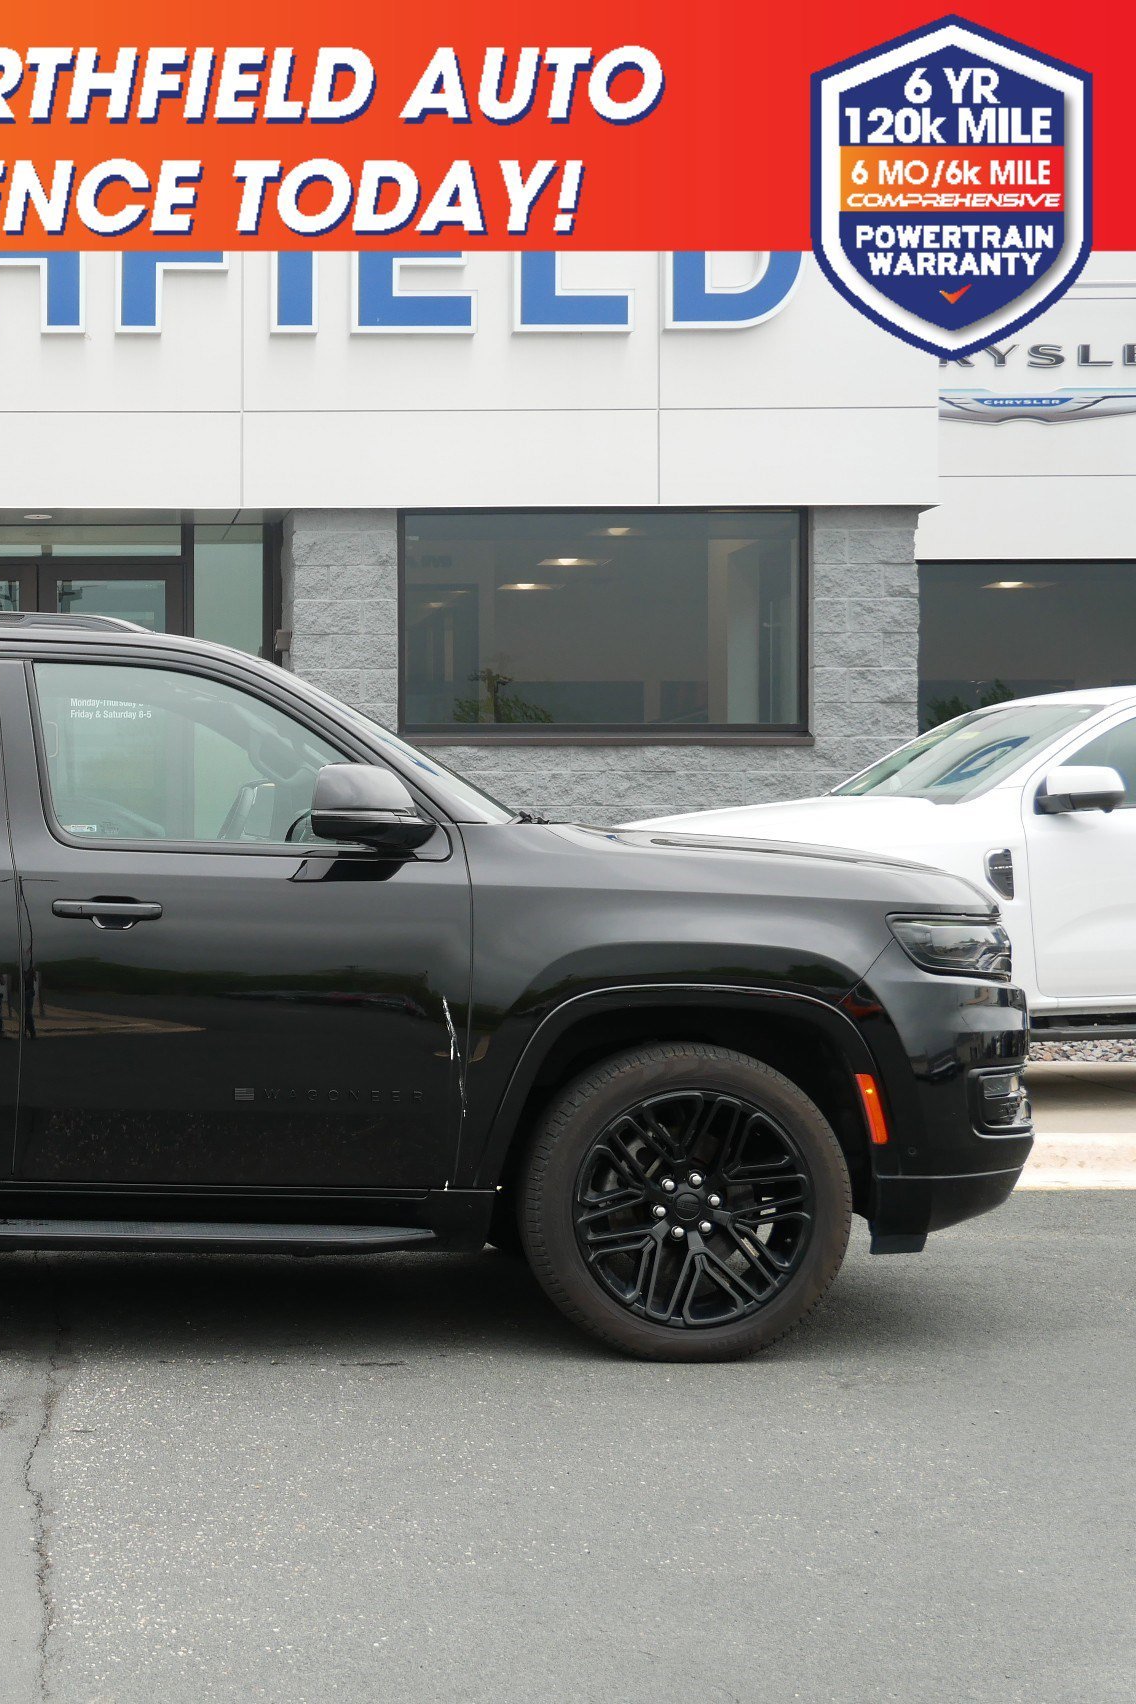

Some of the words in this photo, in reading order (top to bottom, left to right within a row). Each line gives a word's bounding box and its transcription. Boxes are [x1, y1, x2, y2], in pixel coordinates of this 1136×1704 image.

[70, 709, 94, 720] Friday
[95, 710, 102, 719] &
[103, 709, 137, 720] Saturday
[138, 710, 152, 719] 8-5
[263, 1088, 424, 1102] WAGONEER
